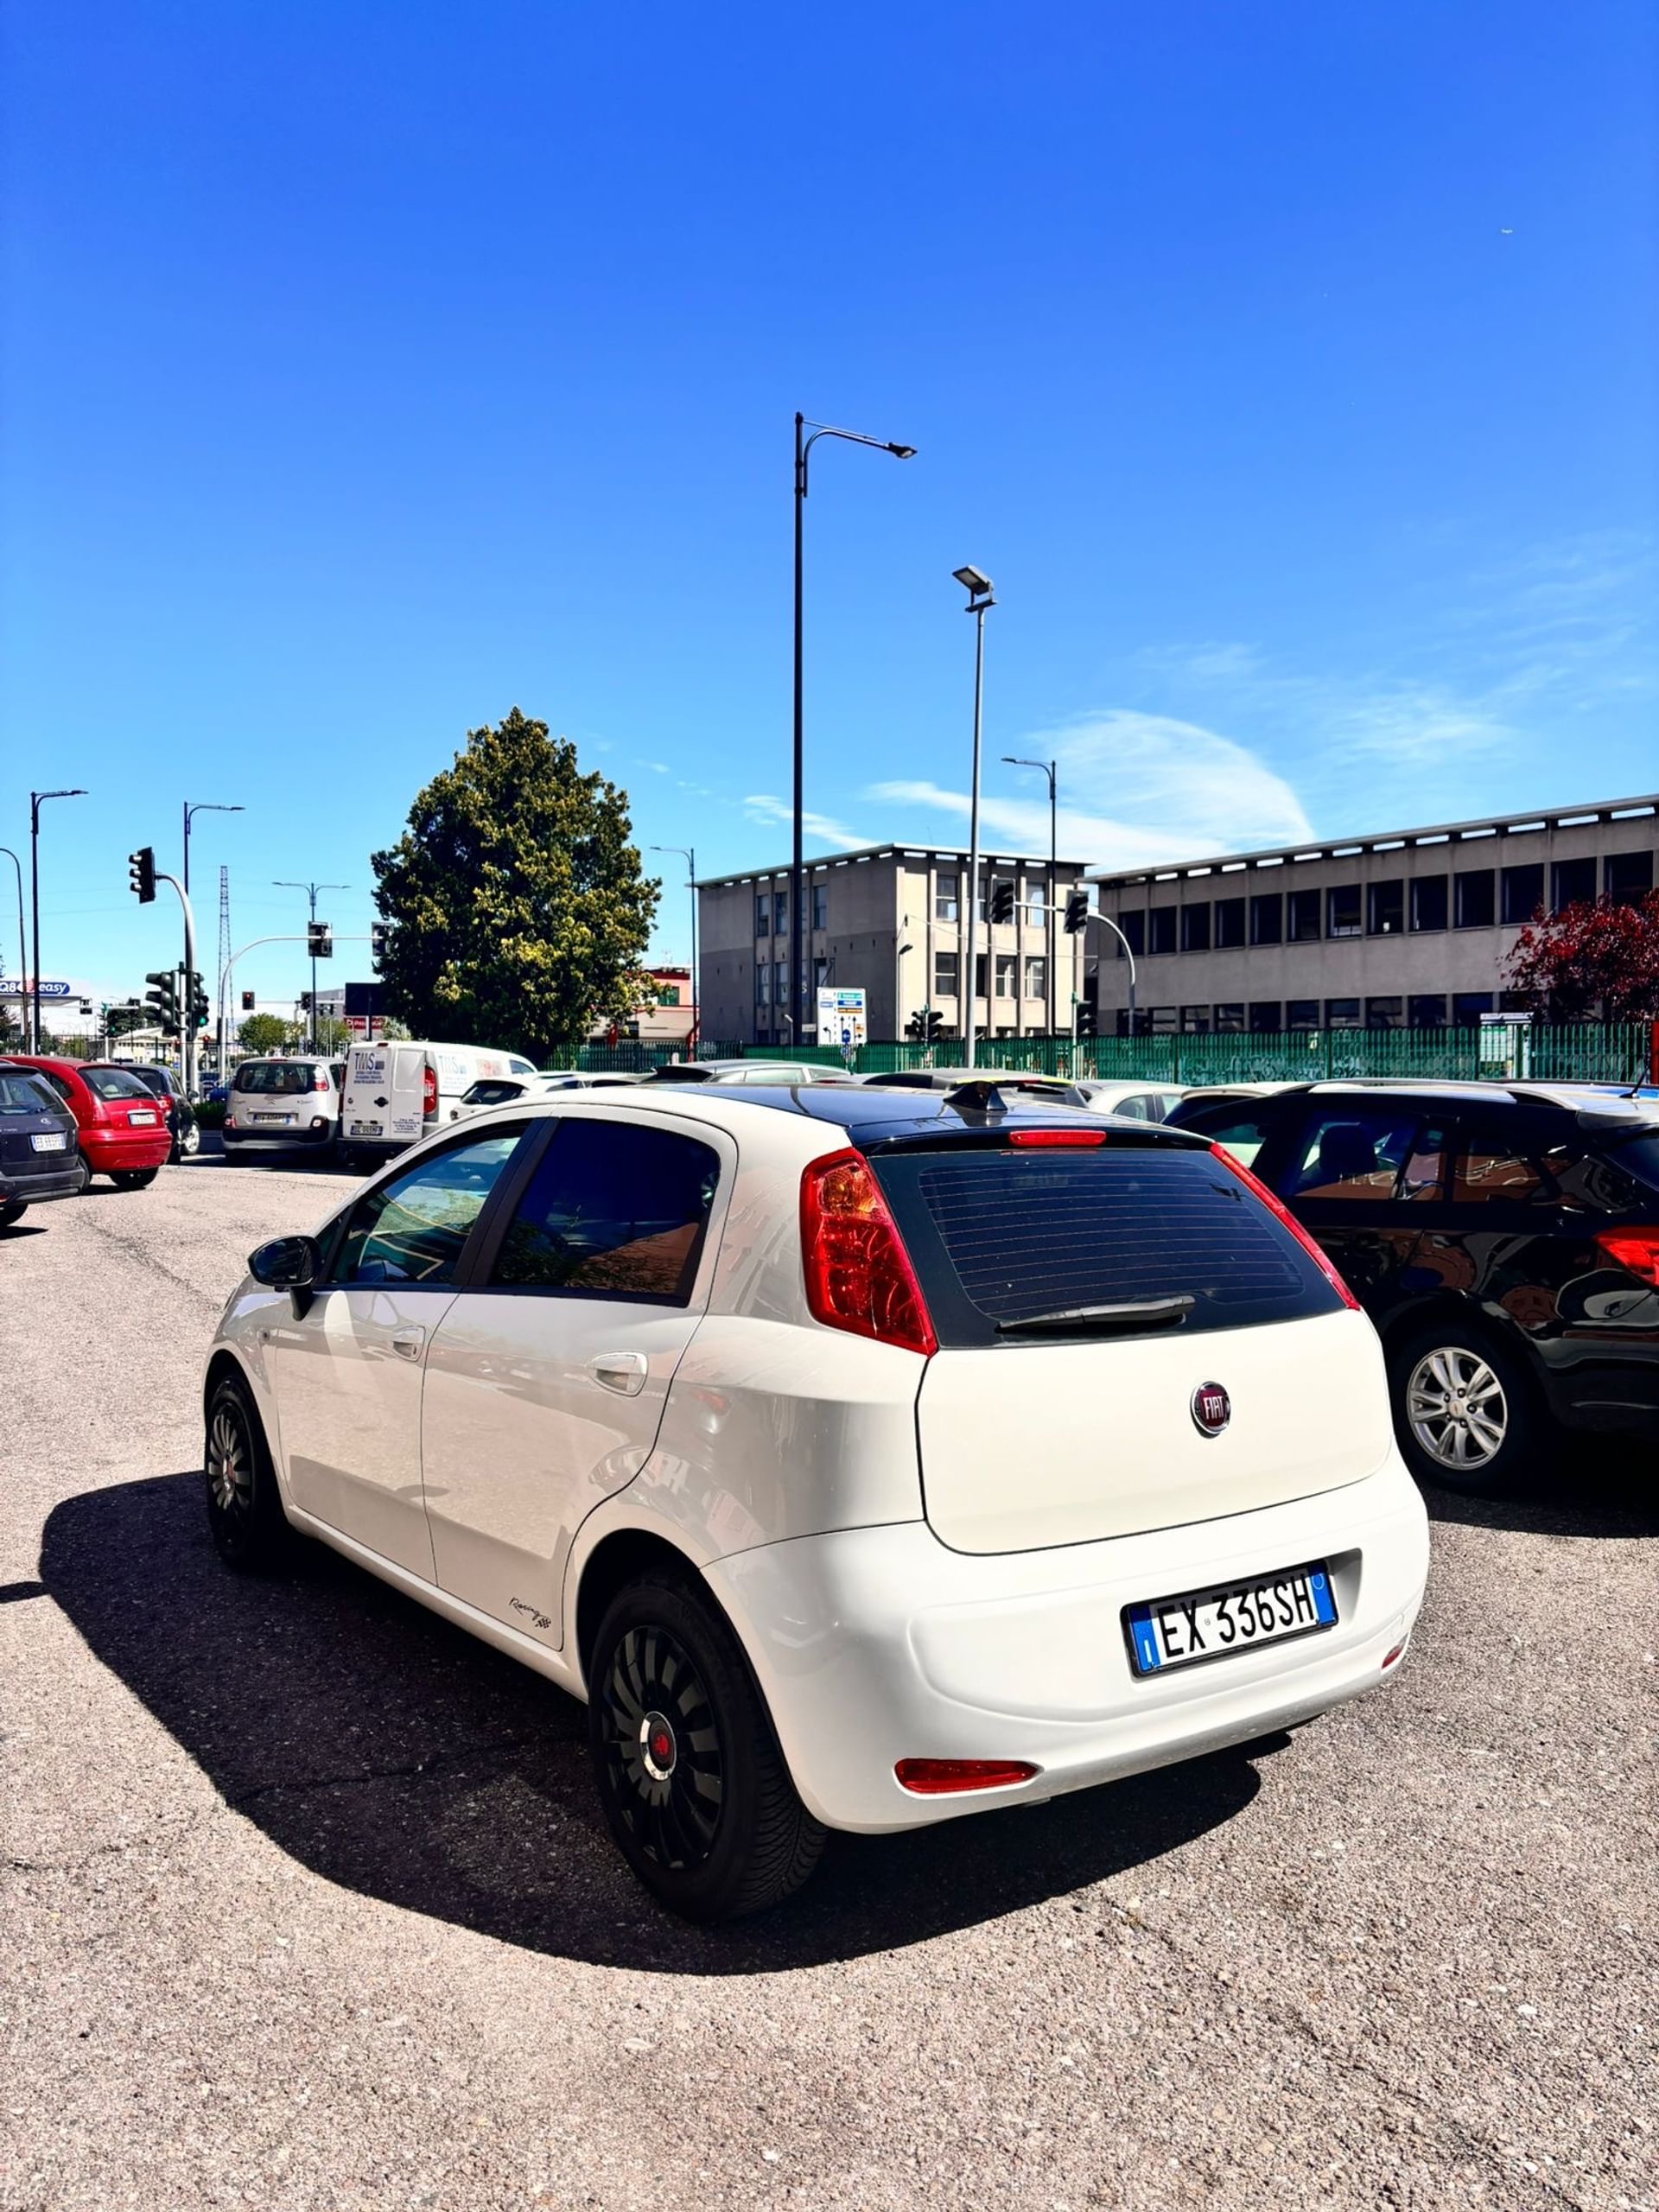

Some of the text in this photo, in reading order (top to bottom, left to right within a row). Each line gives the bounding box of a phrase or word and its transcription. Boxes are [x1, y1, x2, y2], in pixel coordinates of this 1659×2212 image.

[0, 982, 67, 995] Q8 easy
[355, 1052, 375, 1071] TMS
[1203, 1395, 1224, 1420] FIAT
[508, 1597, 546, 1621] Racing
[1157, 1599, 1206, 1658] EX
[1211, 1573, 1315, 1643] 336SH
